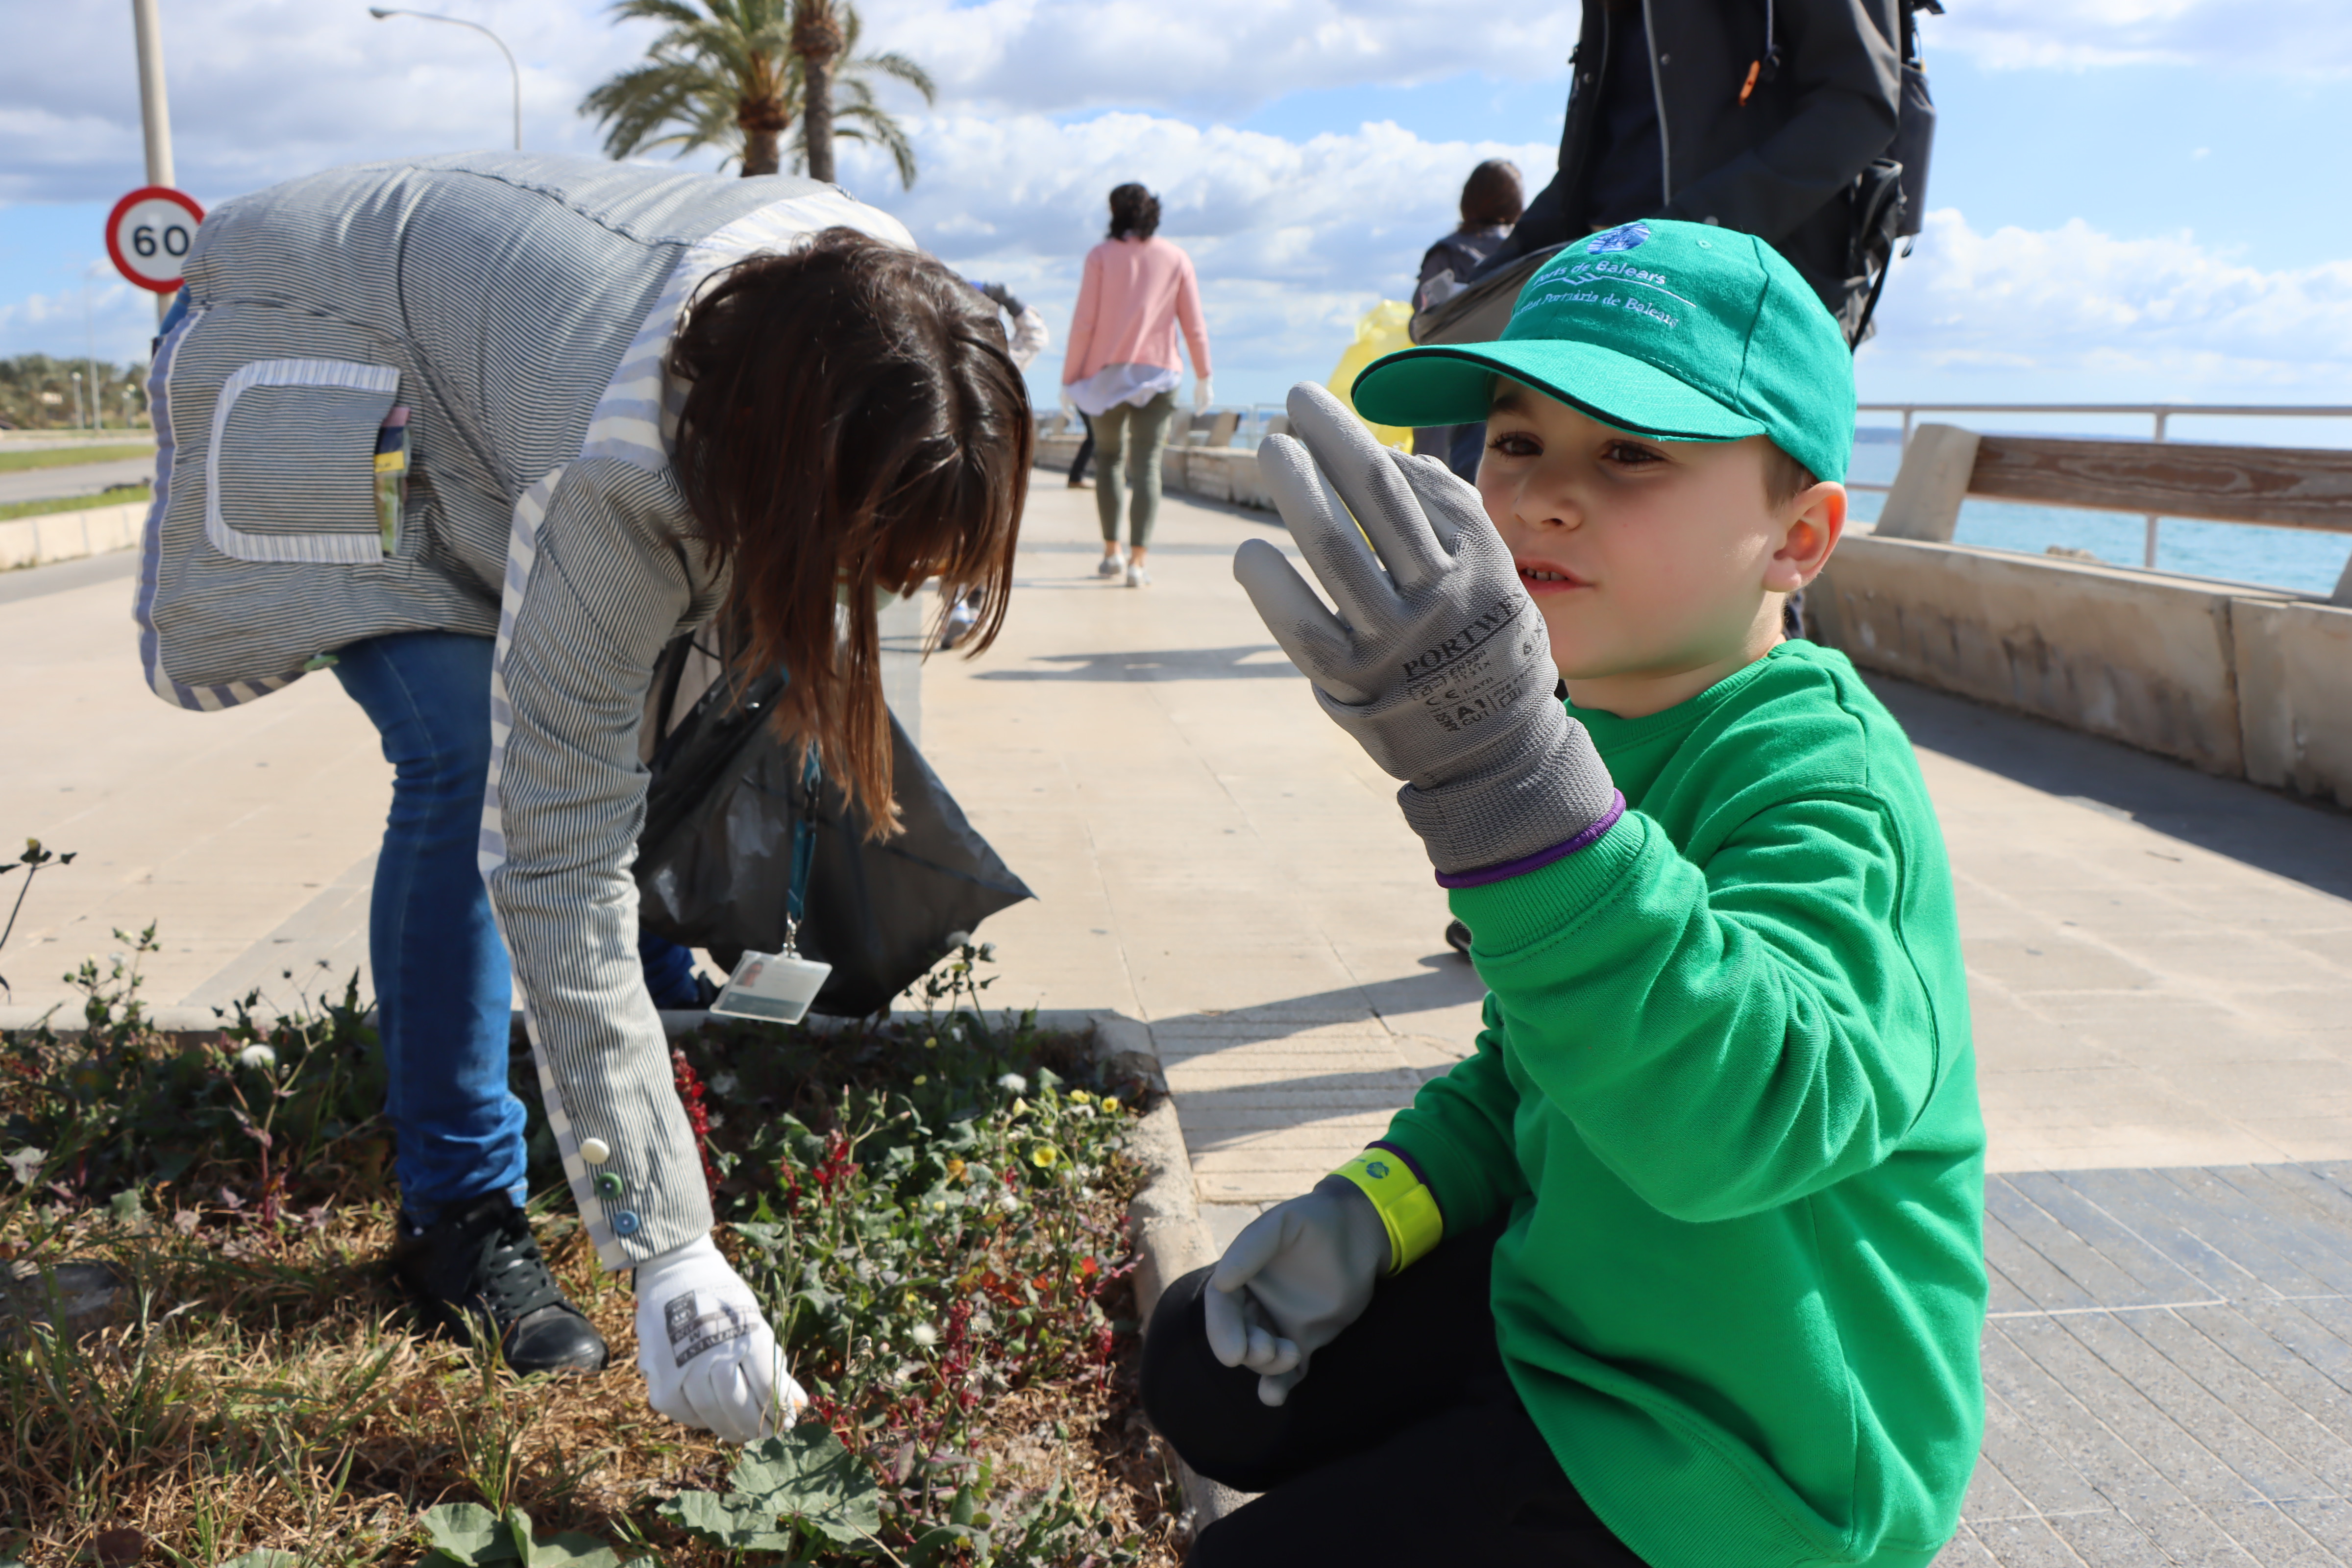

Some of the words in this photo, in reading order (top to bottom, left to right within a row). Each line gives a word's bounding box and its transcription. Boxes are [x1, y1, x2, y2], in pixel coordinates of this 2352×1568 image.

[133, 225, 189, 257] 60
[1570, 262, 1592, 273] de
[1595, 260, 1666, 284] Balears
[1602, 293, 1621, 306] de
[1624, 297, 1679, 328] Balears
